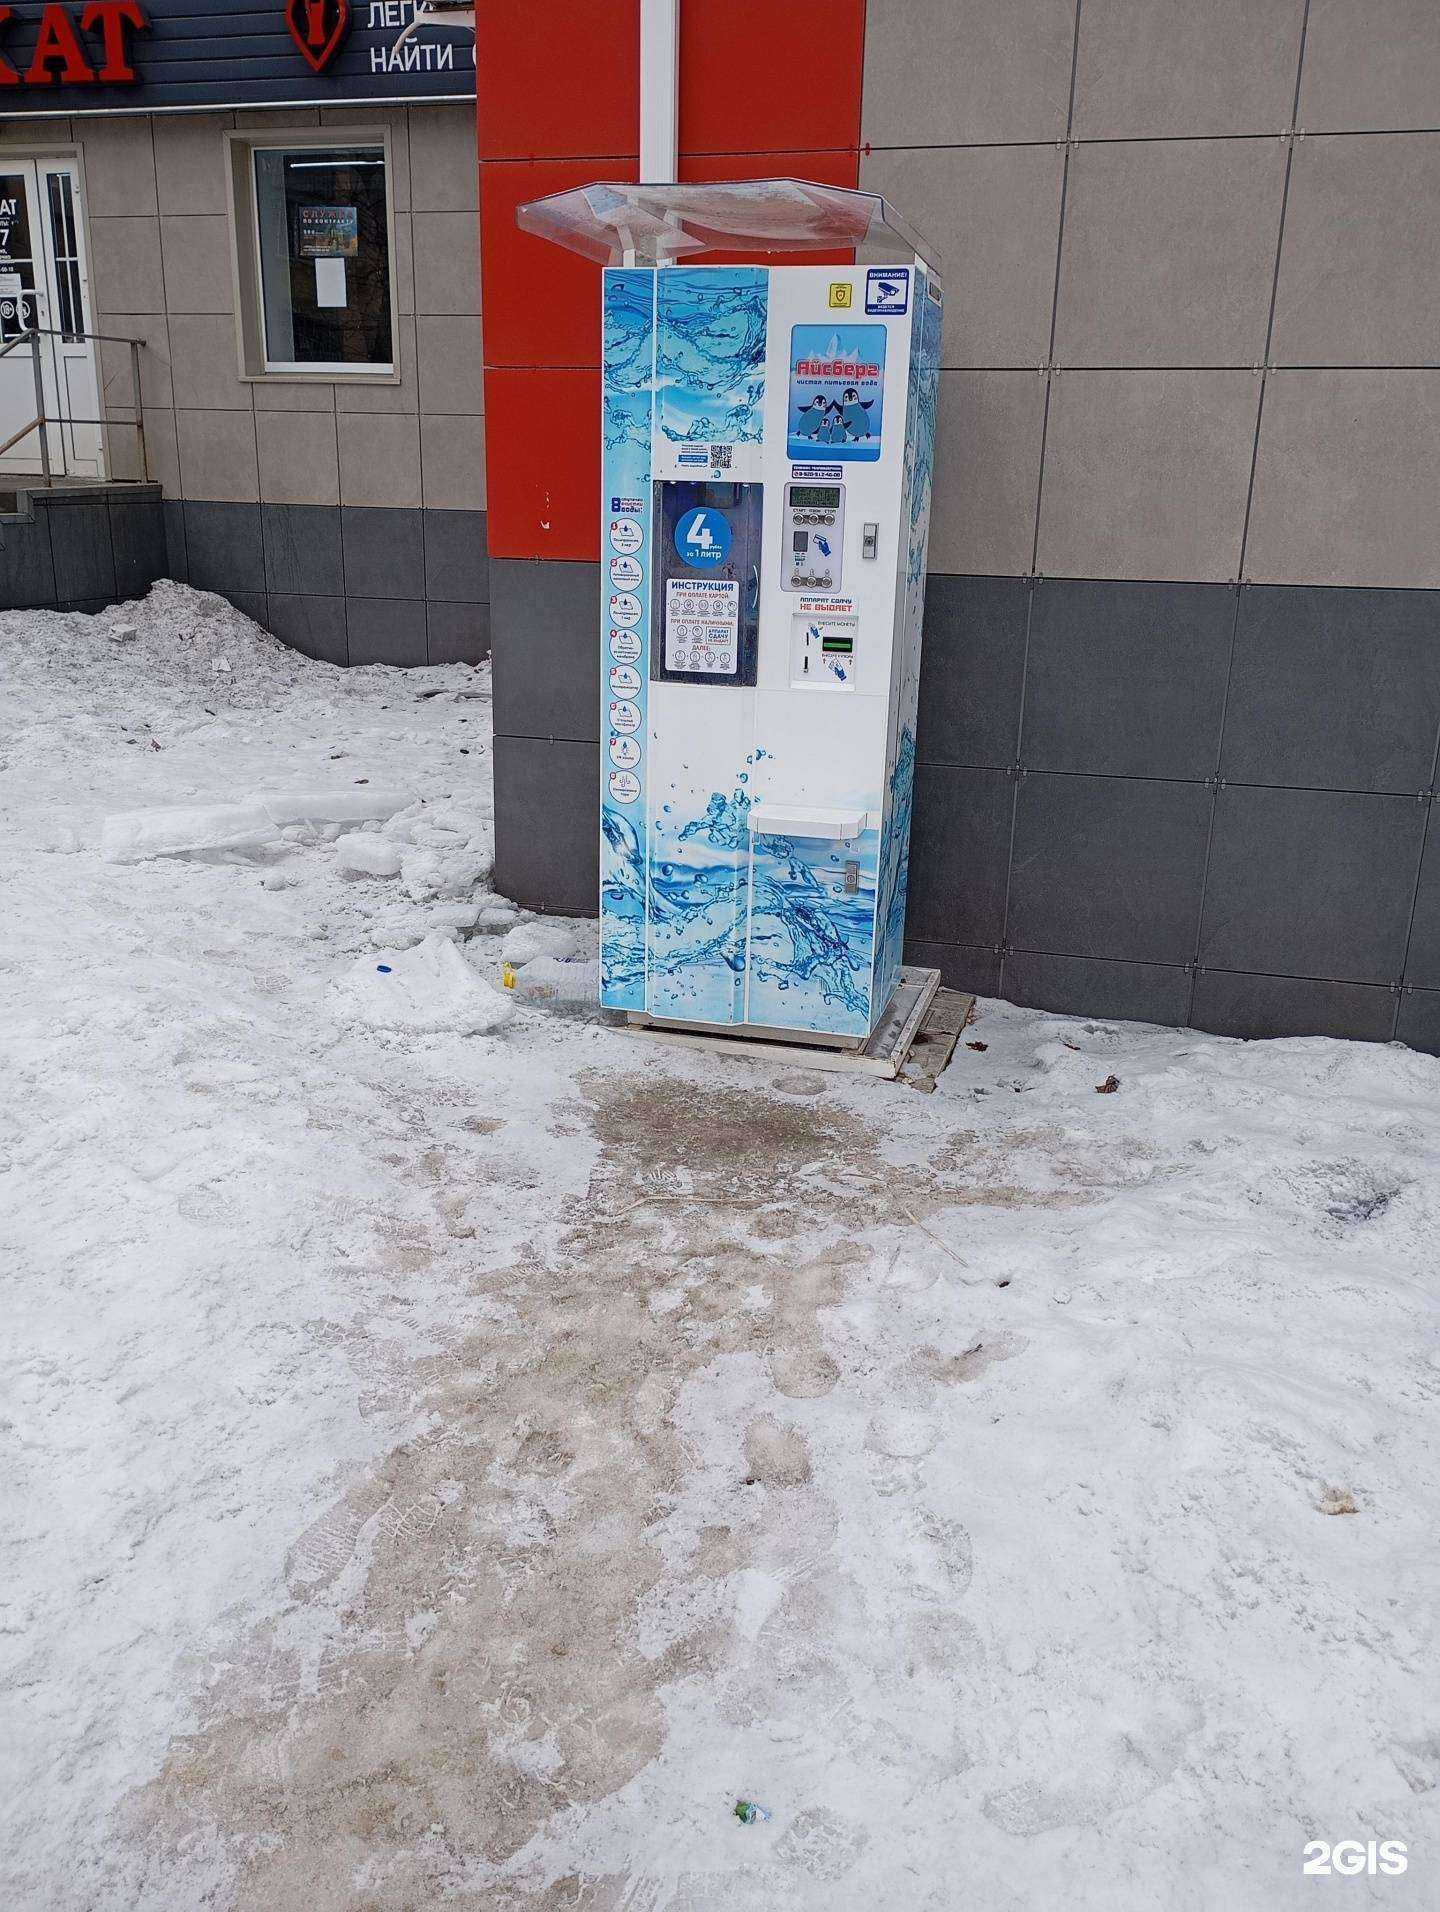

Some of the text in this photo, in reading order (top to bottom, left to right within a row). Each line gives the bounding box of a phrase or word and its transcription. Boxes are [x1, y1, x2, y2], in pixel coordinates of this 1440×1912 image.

[370, 37, 453, 72] НАЙТИ
[796, 360, 880, 379] Айсберг
[687, 513, 714, 550] 4
[700, 552, 722, 560] литр
[671, 582, 734, 592] ИНСТРУКЦИЯ
[800, 603, 853, 612] НЕ ВЫДАЕТ
